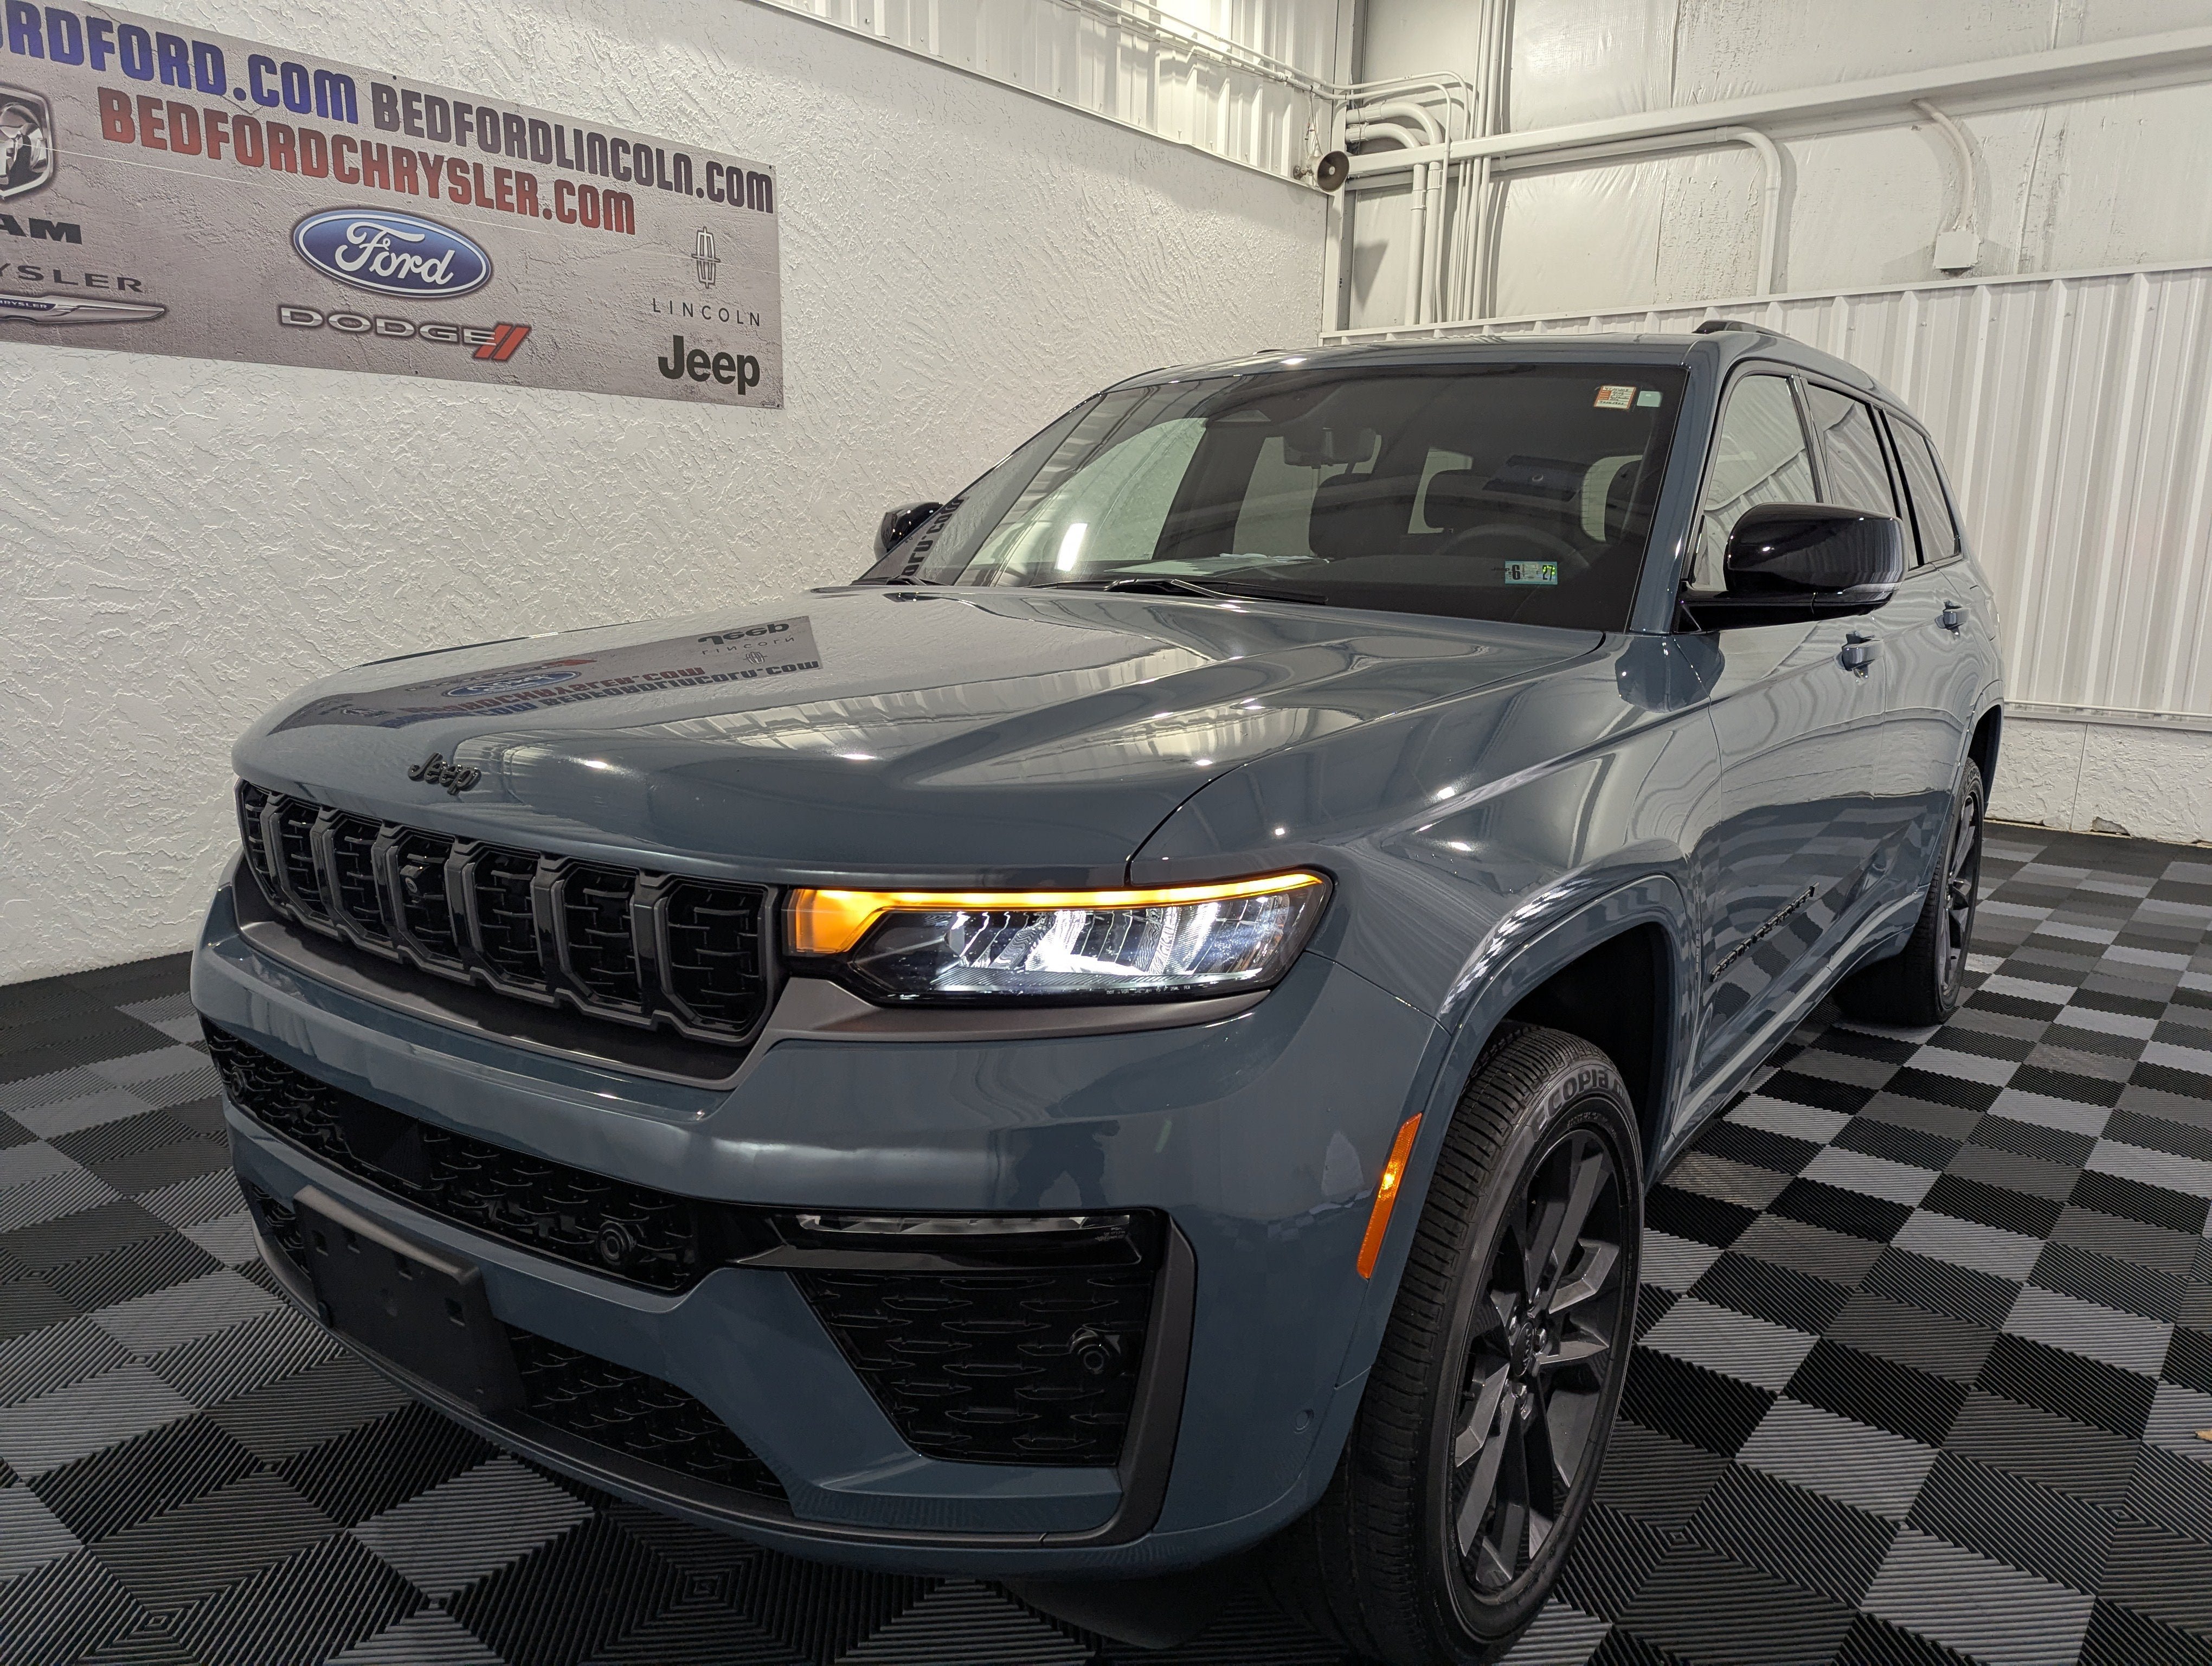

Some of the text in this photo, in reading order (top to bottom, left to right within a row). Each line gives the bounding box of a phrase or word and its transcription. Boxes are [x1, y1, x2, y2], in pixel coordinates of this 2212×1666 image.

[0, 0, 774, 214] RDFORD.COM BEDFORDLINCOLN.COM
[97, 86, 635, 235] BEDFORDCHRYSLER.COM
[334, 221, 455, 285] Ford
[280, 306, 497, 347] DODGE
[652, 298, 760, 327] LINCOLN
[658, 334, 761, 396] Jeep
[1512, 564, 1521, 581] 6
[1542, 564, 1555, 582] 27
[407, 751, 482, 796] Jeep
